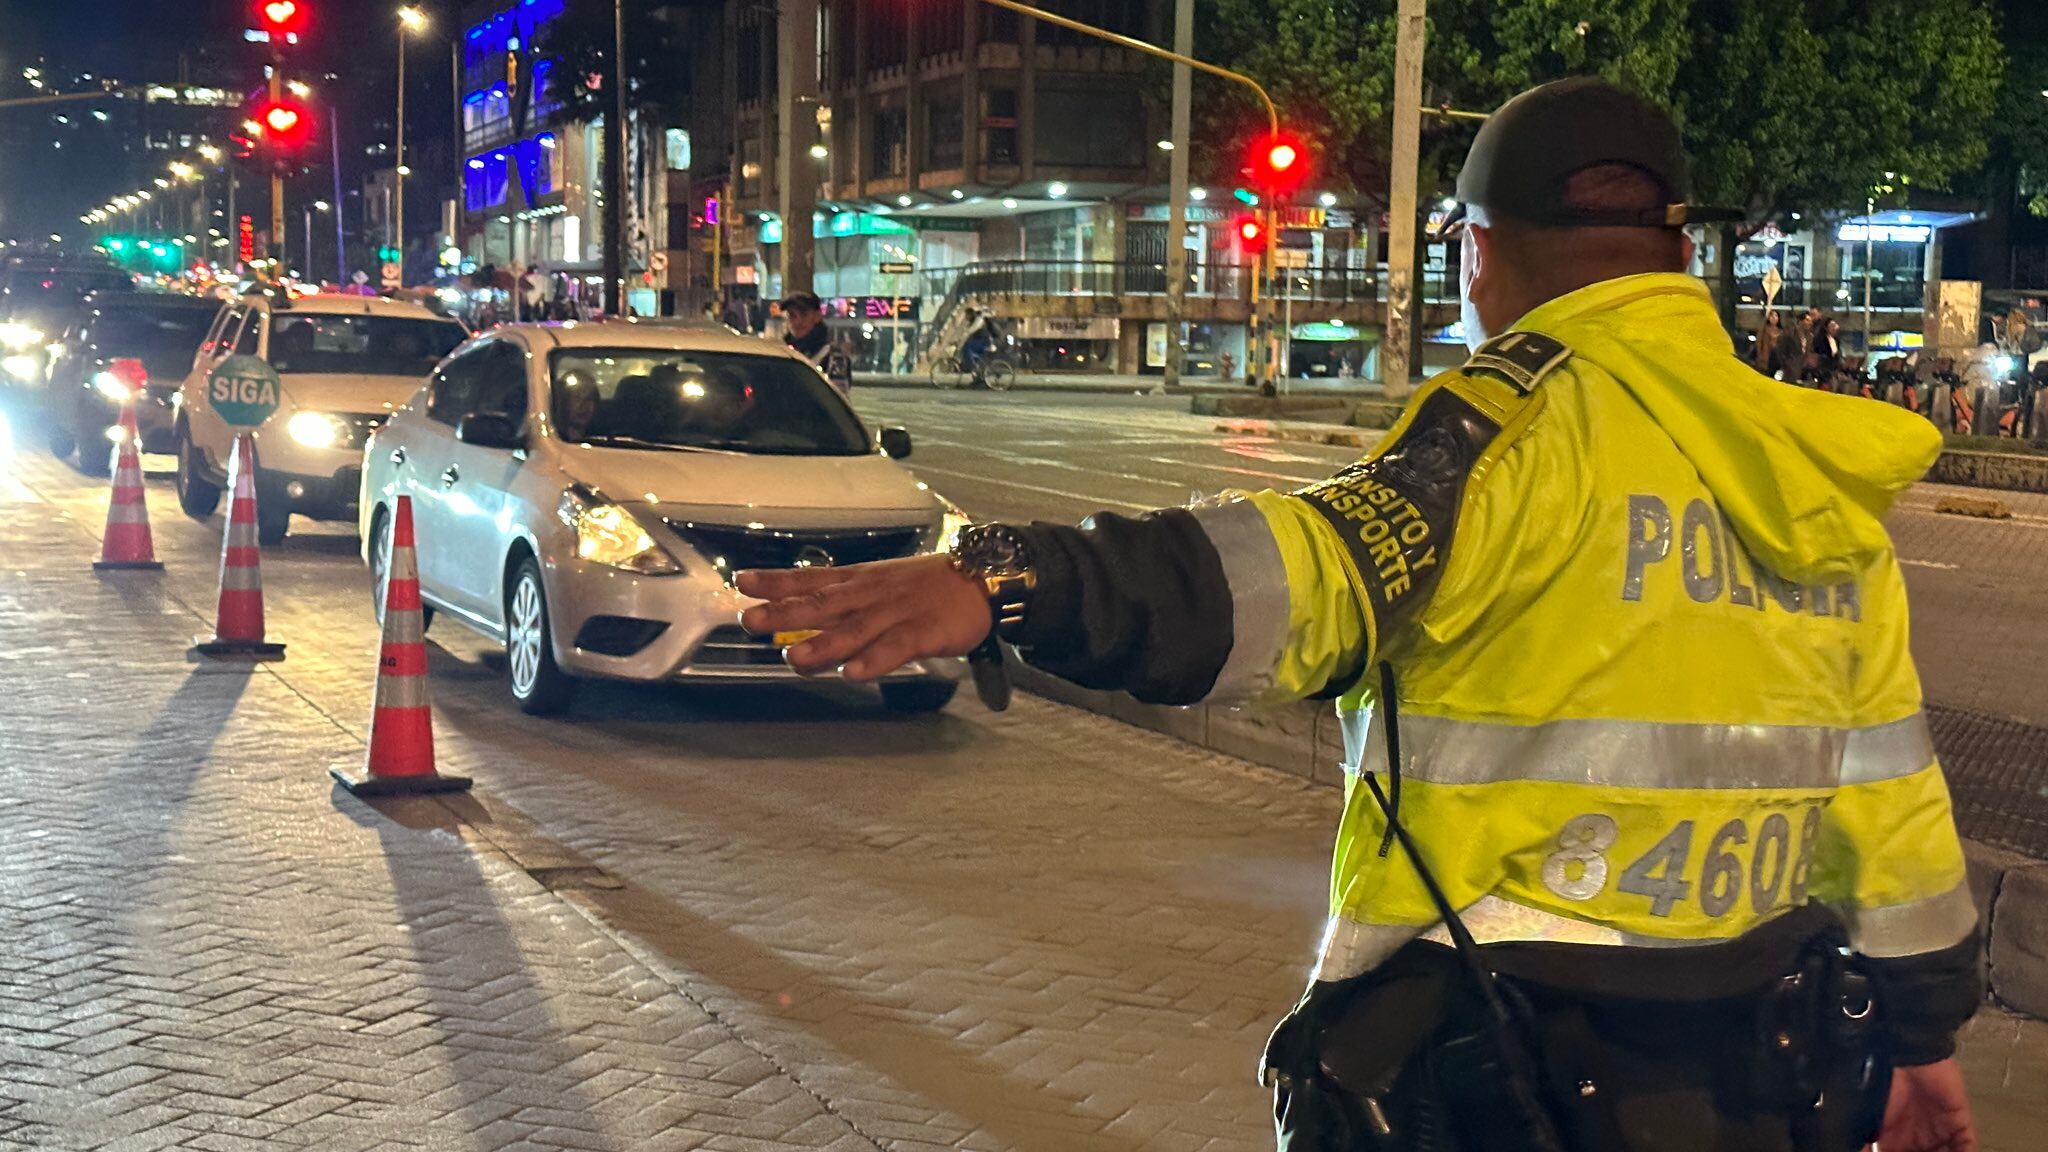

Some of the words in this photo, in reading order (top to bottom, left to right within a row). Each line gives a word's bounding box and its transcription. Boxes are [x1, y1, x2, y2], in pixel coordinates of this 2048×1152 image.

[212, 376, 276, 405] SIGA
[1313, 485, 1411, 603] NSPORTE
[1341, 473, 1430, 545] NSITO
[1411, 545, 1437, 571] Y
